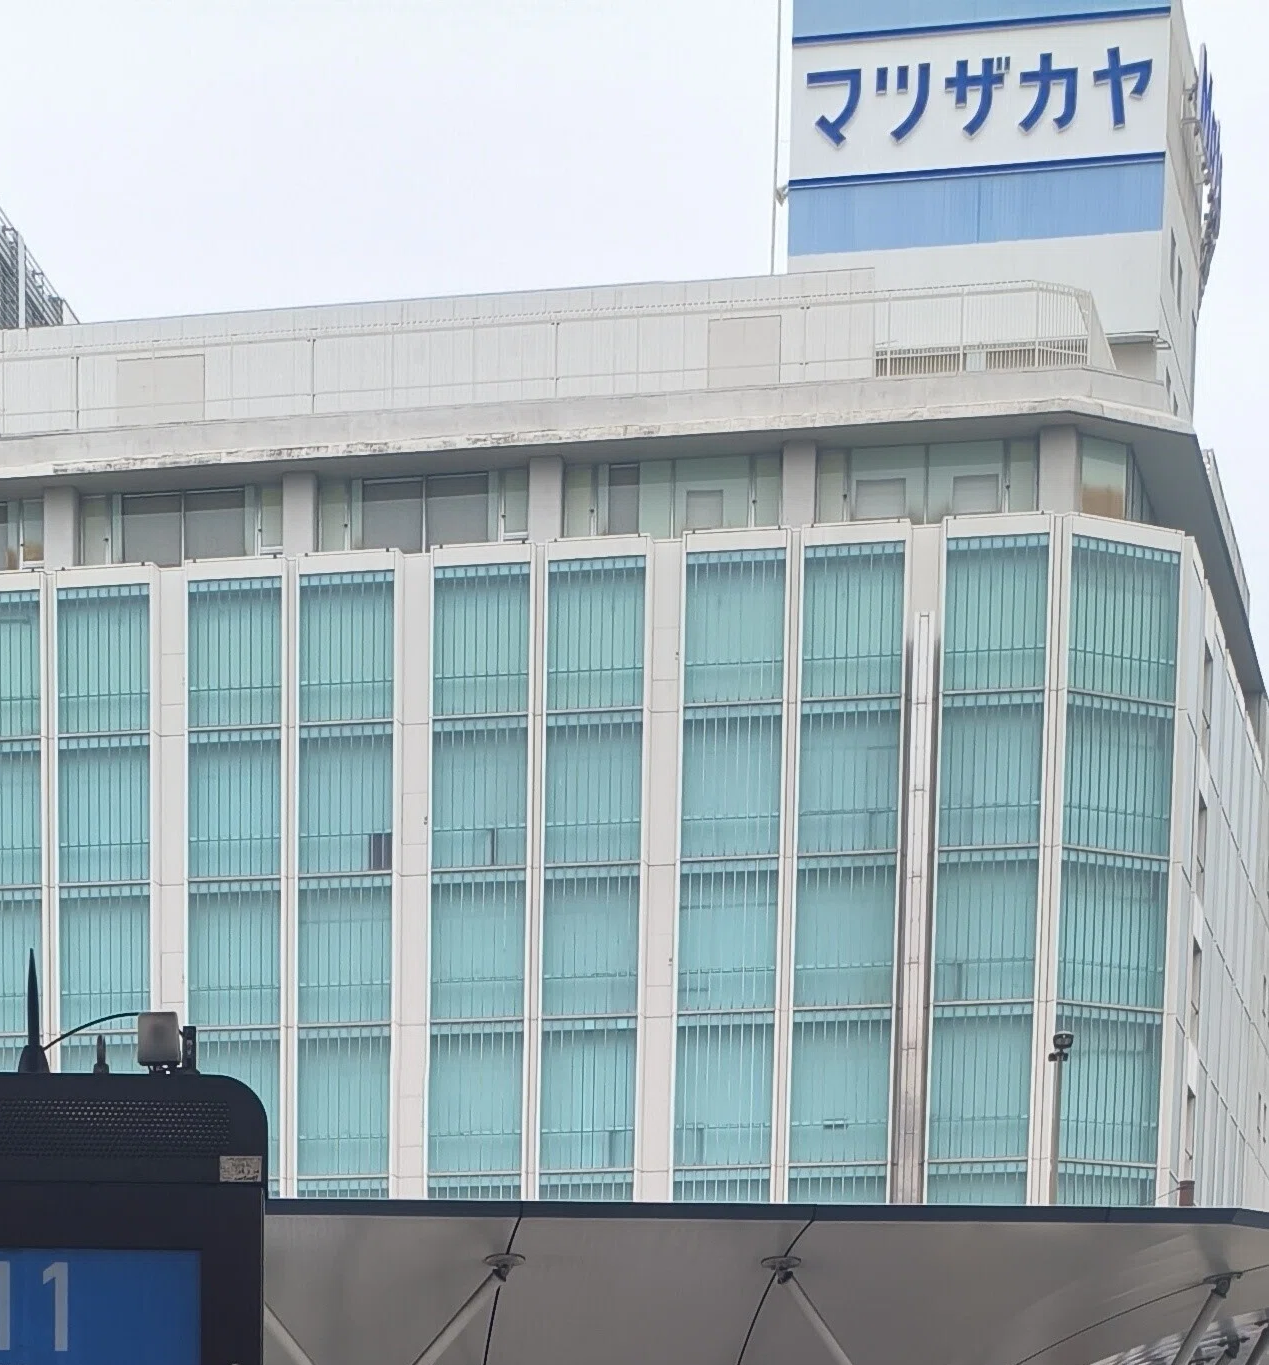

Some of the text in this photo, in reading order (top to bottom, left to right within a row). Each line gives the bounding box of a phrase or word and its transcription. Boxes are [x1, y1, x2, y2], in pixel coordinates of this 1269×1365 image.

[807, 47, 1153, 148] マツザカヤ
